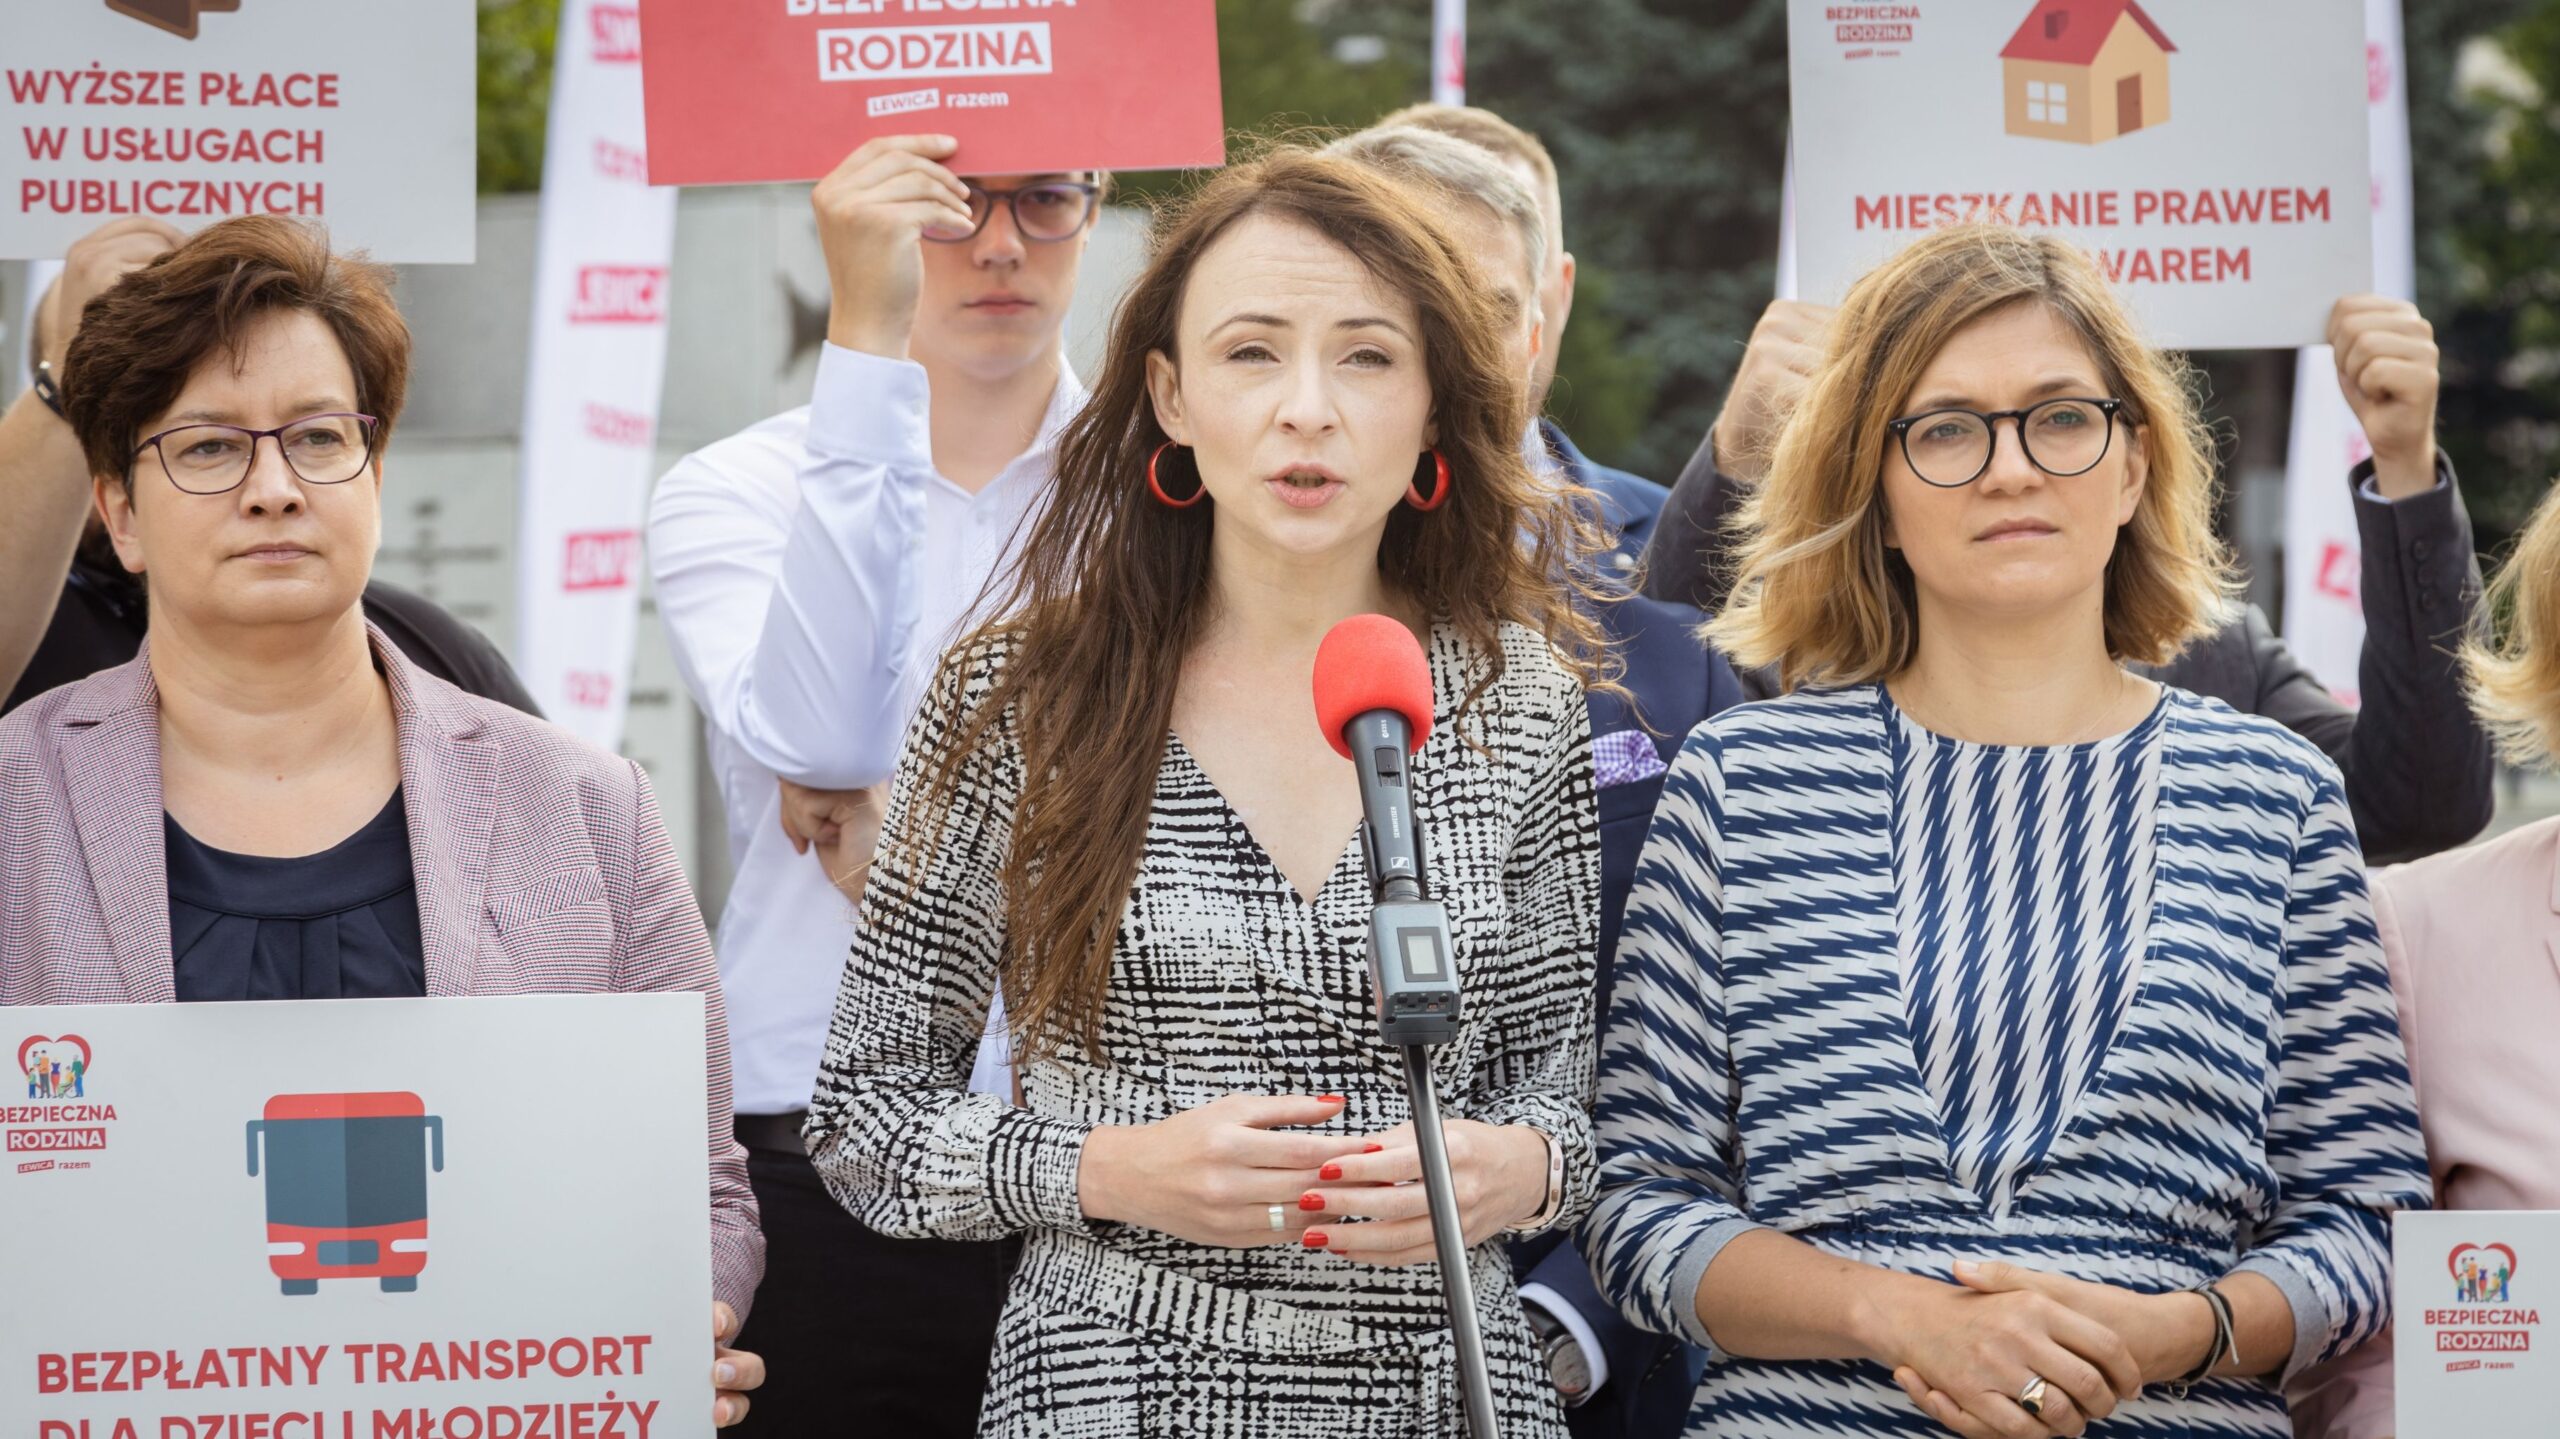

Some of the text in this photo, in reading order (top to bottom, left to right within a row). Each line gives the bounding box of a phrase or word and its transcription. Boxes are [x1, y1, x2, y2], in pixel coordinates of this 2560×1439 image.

[1825, 5, 1921, 20] BEZPIECZNA
[1839, 25, 1910, 40] RODZINA
[827, 30, 1044, 72] RODZINA
[6, 61, 339, 108] WYŻSZE PŁACE
[871, 91, 1009, 113] LEWICA razem
[22, 126, 324, 164] W USŁUGACH
[21, 179, 324, 215] PUBLICZNYCH
[1854, 187, 2332, 230] MIESZKANIE PRAWEM
[9, 1130, 103, 1149] RODZINA
[19, 1160, 91, 1173] LEWICA razem
[2424, 1309, 2540, 1325] BEZPIECZNA
[2439, 1332, 2527, 1350] RODZINA
[37, 1335, 653, 1394] BEZPŁATNY TRANSPORT
[372, 1390, 661, 1439] MŁODZIEŻY
